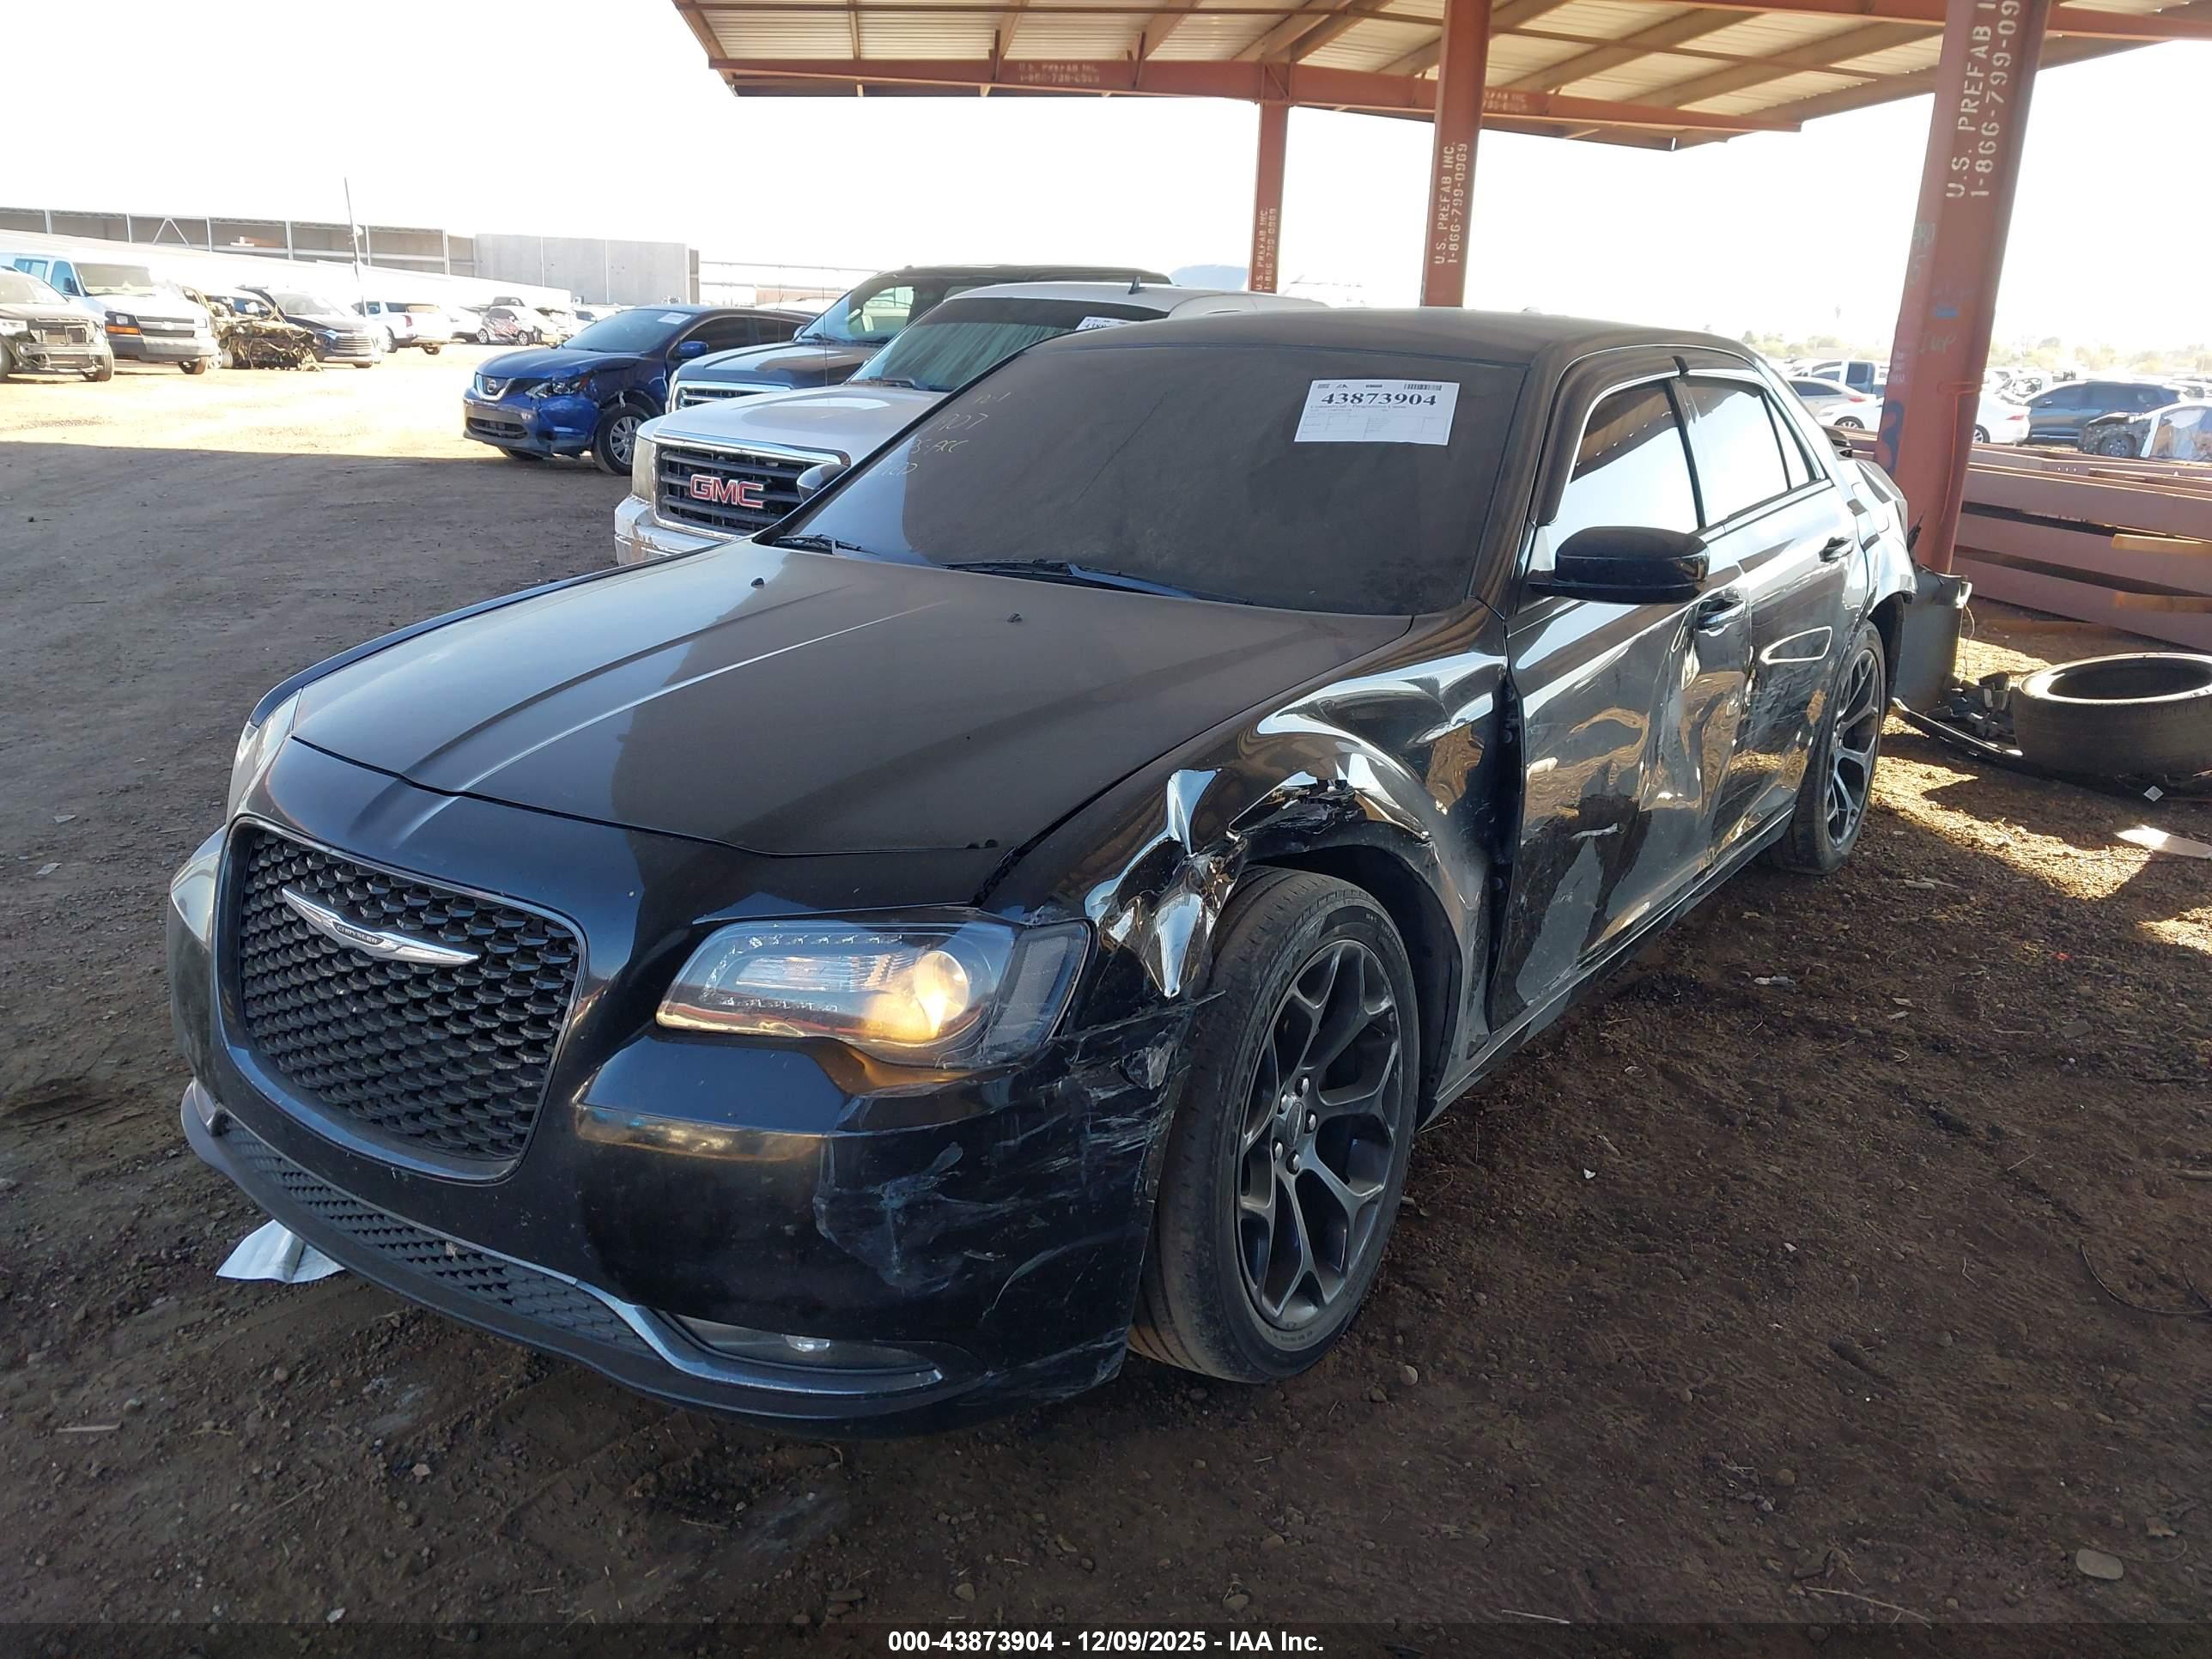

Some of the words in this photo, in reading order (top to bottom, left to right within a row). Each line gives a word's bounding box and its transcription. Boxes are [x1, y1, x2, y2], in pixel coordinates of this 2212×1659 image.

[1957, 26, 1991, 131] PREFAB
[1443, 142, 1455, 168] INC.
[1946, 149, 1972, 198] U.S.
[1437, 175, 1452, 230] PREFAB
[1435, 239, 1447, 264] U.S.
[1322, 392, 1437, 406] 43873904
[690, 473, 764, 508] GMC
[337, 925, 378, 944] CHRYSLER
